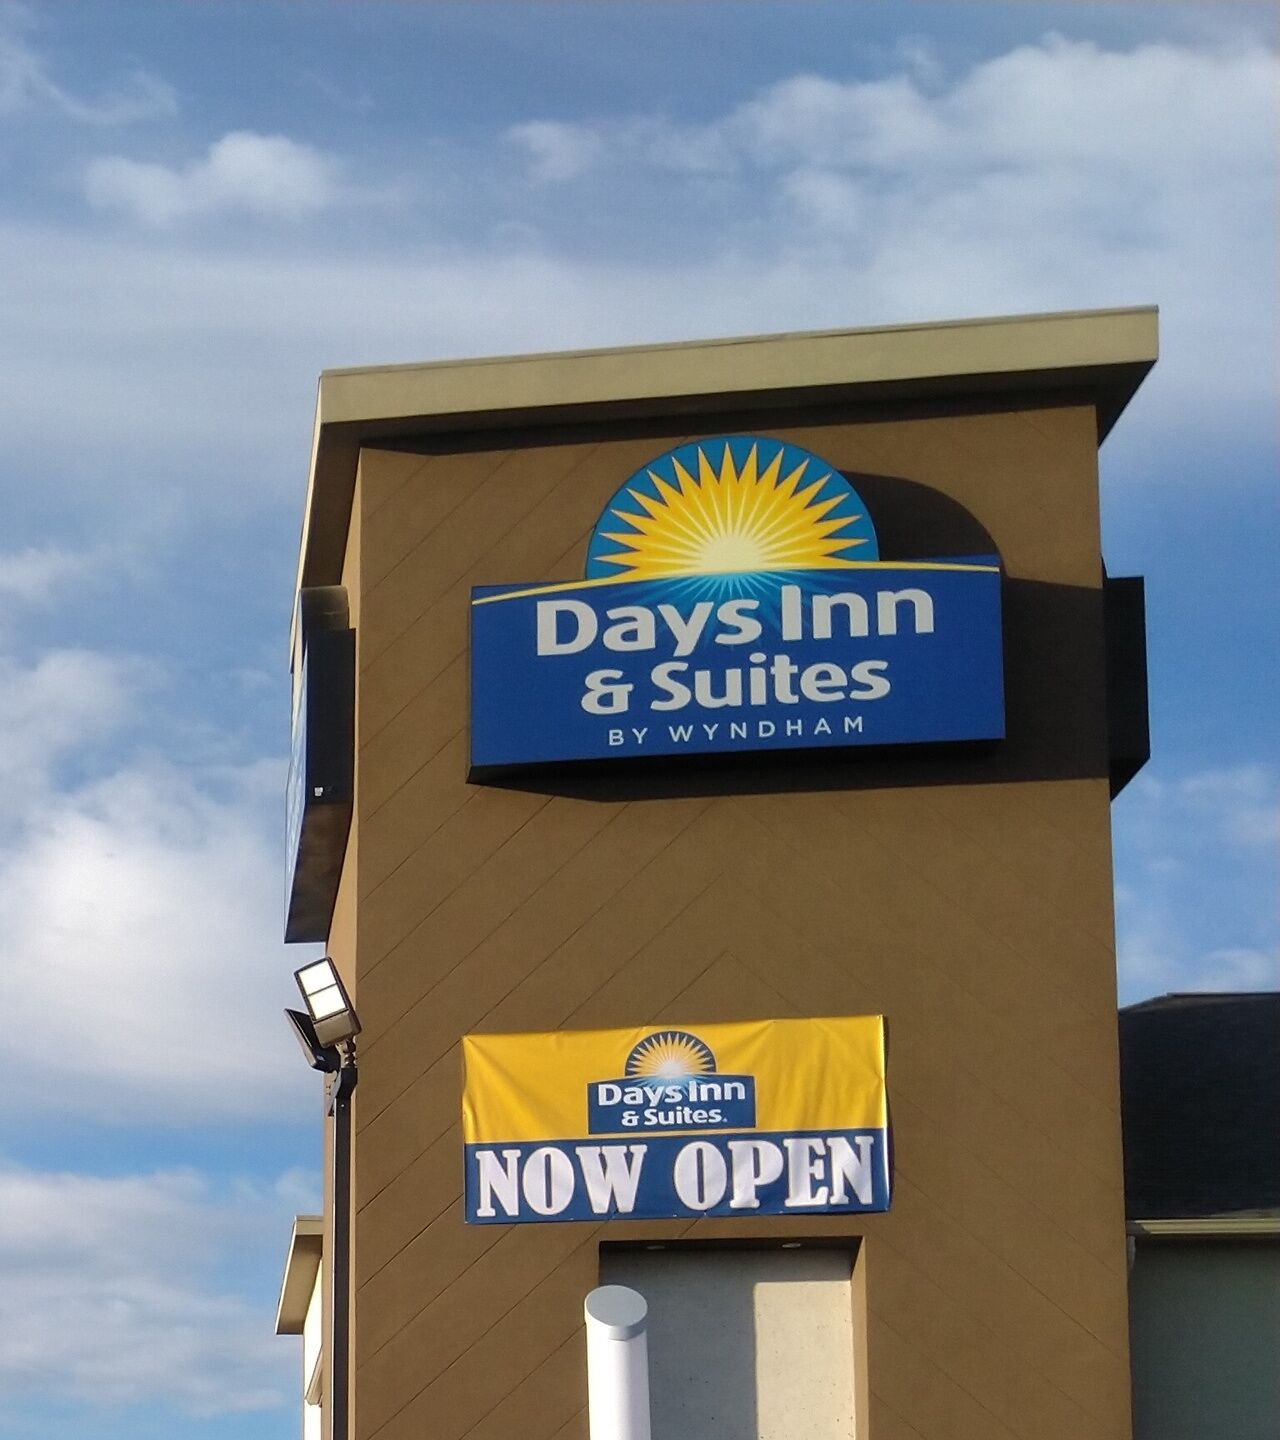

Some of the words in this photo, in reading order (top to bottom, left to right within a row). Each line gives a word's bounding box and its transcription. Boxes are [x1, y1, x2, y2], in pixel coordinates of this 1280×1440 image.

[536, 595, 762, 657] Days
[781, 584, 935, 641] Inn
[580, 668, 633, 715] &
[649, 652, 891, 711] Suites
[608, 727, 648, 747] BY
[668, 715, 865, 744] WYNDHAM
[597, 1082, 682, 1107] Days
[689, 1080, 746, 1102] Inn
[621, 1109, 639, 1127] &
[643, 1106, 724, 1126] Suites
[474, 1143, 648, 1218] NOW
[673, 1135, 875, 1211] OPEN
